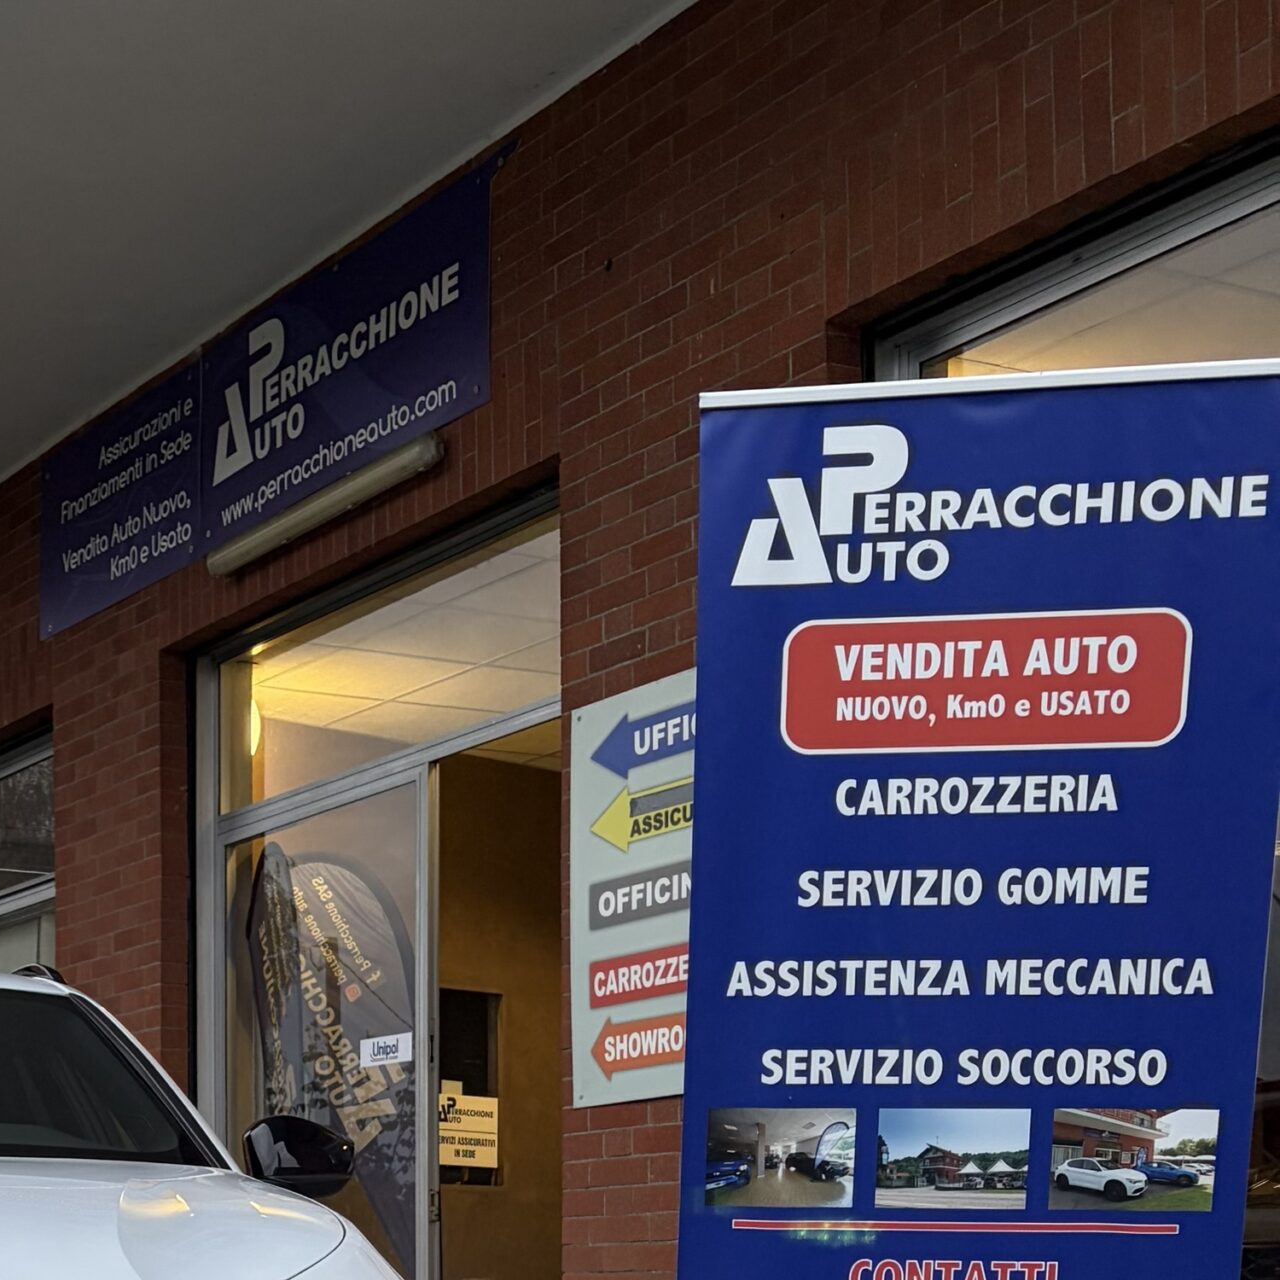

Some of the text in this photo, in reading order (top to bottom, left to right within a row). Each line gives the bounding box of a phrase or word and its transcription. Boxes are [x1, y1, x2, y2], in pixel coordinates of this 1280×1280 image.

[248, 262, 460, 423] PERRACCHIONE
[98, 398, 193, 470] Assicurazioni e
[212, 381, 306, 488] AUTO
[221, 379, 457, 527] www.perracchioneauto.com
[60, 430, 193, 524] Finanziamenti in Sede
[820, 424, 1269, 536] PERRACCHIONE
[63, 490, 192, 573] Vendita Auto Nuovo,
[110, 521, 192, 581] Km0 e Usato
[731, 477, 951, 586] AUTO
[834, 634, 1138, 682] VENDITA AUTO
[835, 688, 1131, 727] NUOVO, Km0 e USATO
[634, 712, 696, 756] UFFI
[835, 773, 1118, 816] CARROZZERIA
[797, 866, 1150, 908] SERVIZIO GOMME
[593, 954, 688, 998] CARROZZE
[726, 958, 1214, 997] ASSISTENZA MECCANICA
[372, 1037, 399, 1060] Unipol
[604, 1025, 686, 1062] SHOWRO
[761, 1048, 1168, 1086] SERVIZIO SOCCORSO
